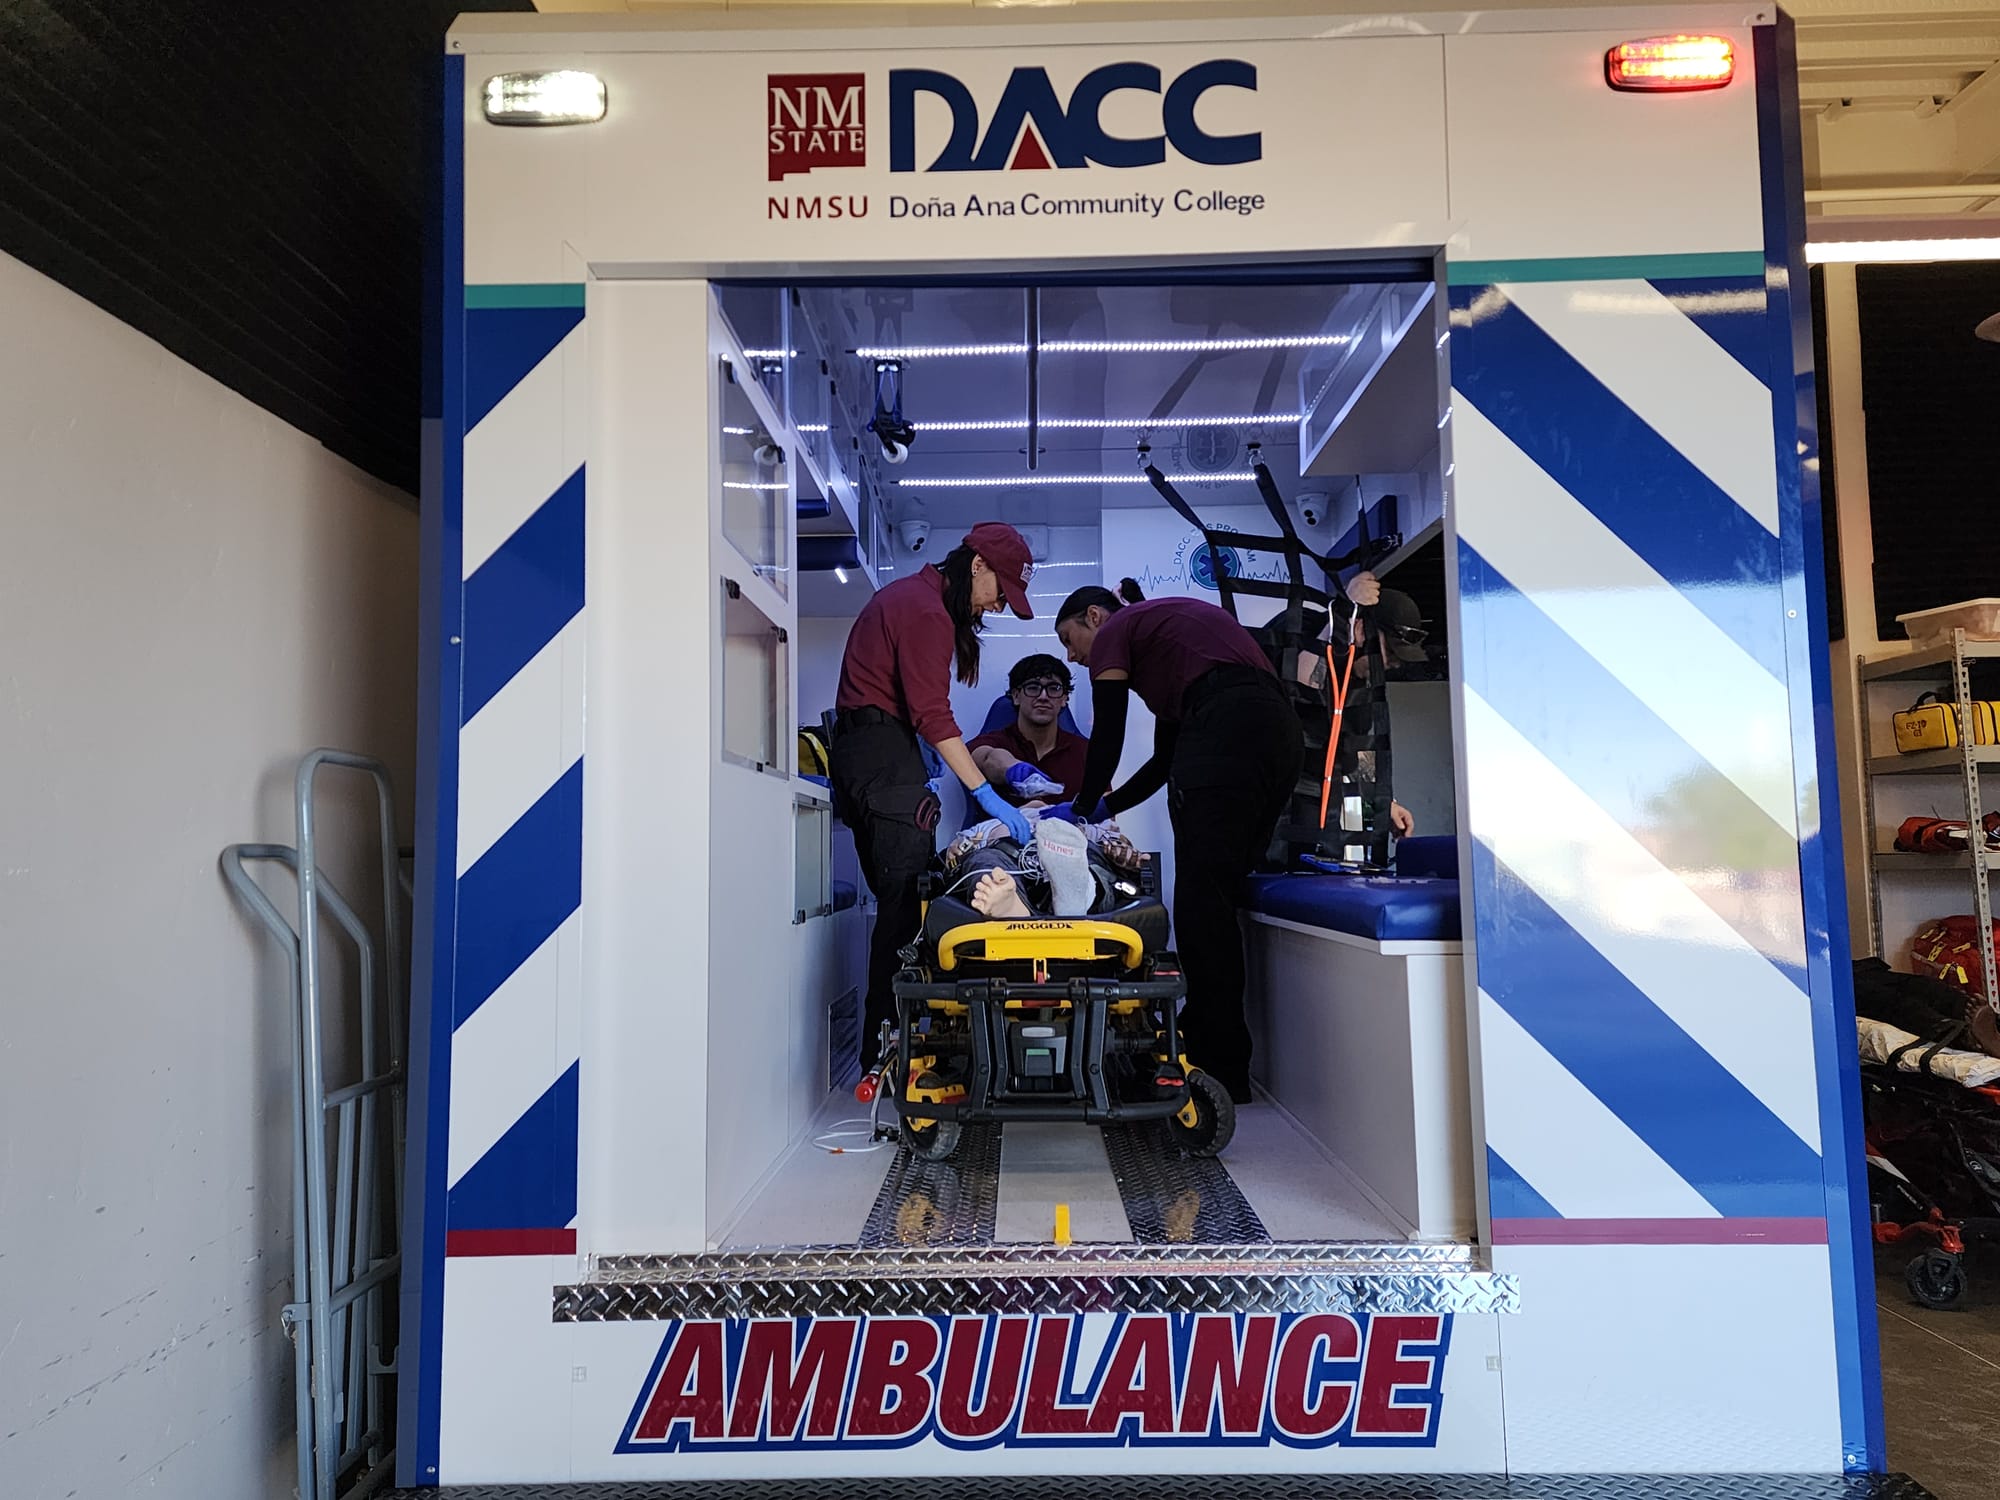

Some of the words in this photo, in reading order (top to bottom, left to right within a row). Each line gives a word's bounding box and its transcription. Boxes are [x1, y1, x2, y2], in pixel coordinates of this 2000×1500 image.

[769, 86, 863, 129] NM
[889, 59, 1262, 172] DACC
[769, 129, 866, 154] STATE
[768, 195, 868, 219] NMSU
[889, 194, 956, 218] Doña
[964, 193, 1016, 217] Ana
[1021, 190, 1164, 218] Community
[1174, 187, 1265, 216] College
[1173, 536, 1191, 565] DACC
[1043, 839, 1074, 855] Hanes
[1013, 922, 1065, 930] RUGGED
[618, 1313, 1453, 1451] AMBULANCE
